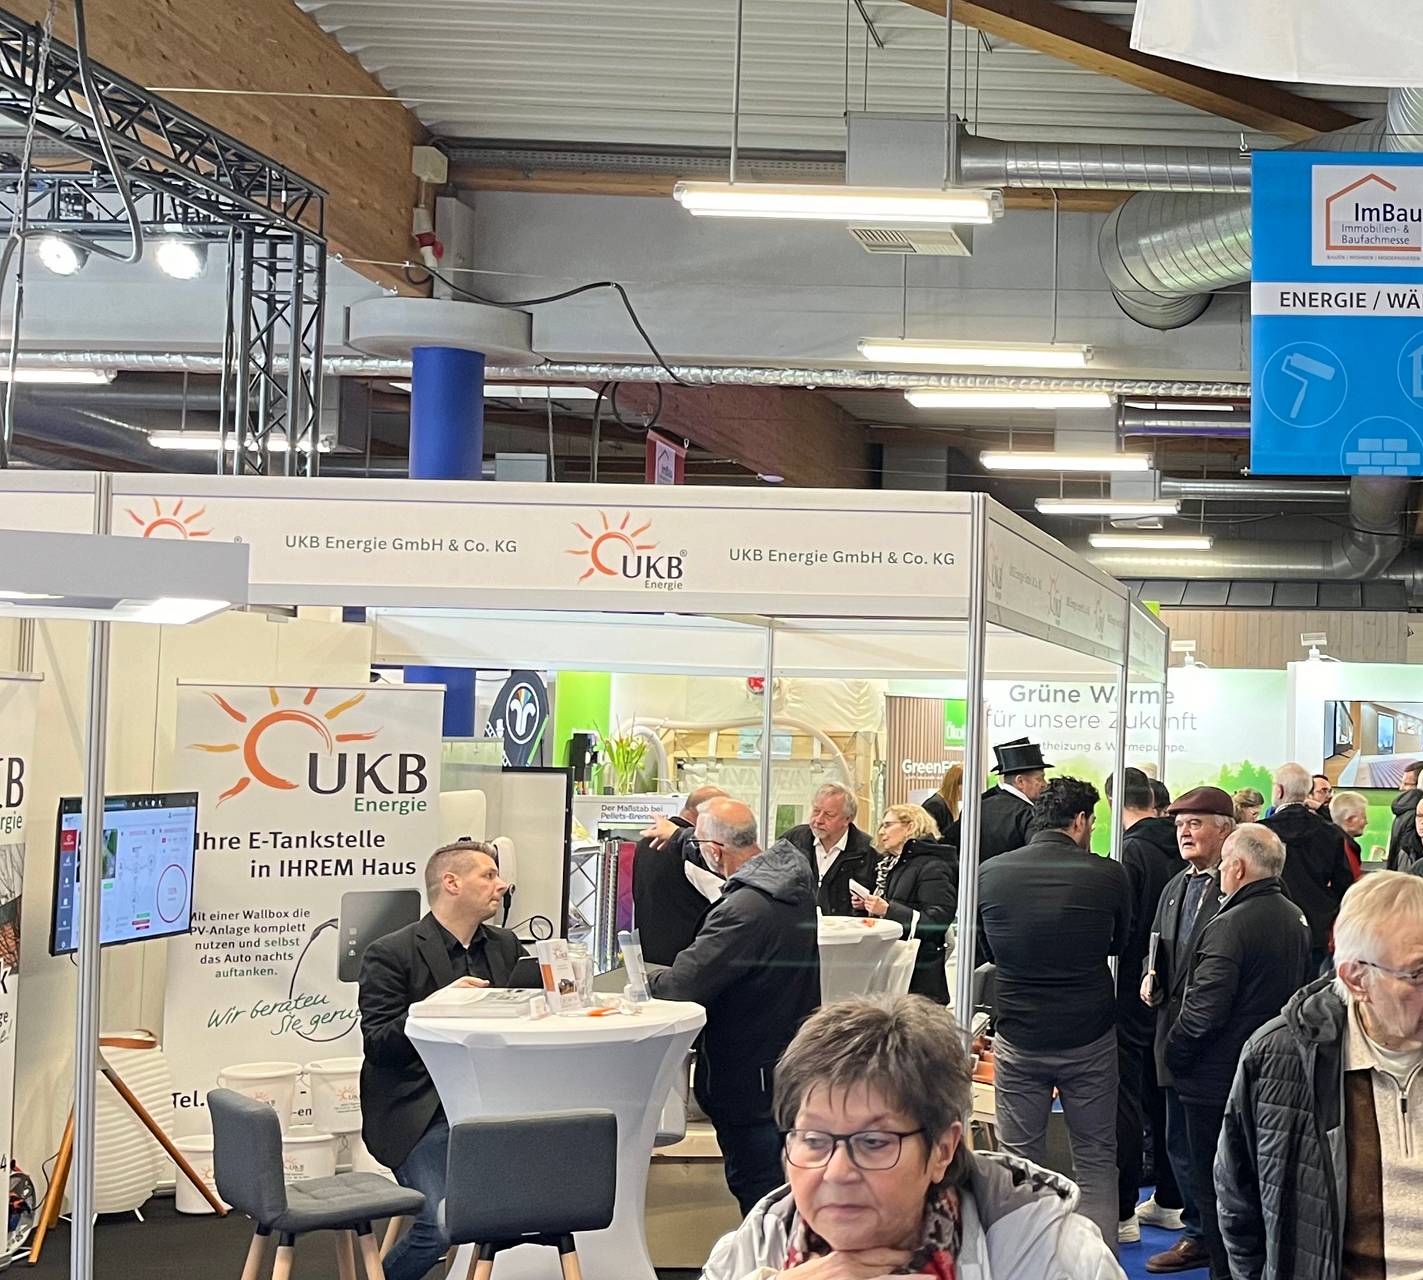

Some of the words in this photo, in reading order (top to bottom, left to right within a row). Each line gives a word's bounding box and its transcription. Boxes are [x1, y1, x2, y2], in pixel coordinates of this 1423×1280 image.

[1355, 203, 1422, 222] ImBau
[1342, 224, 1400, 233] Immobilien-
[1403, 225, 1409, 233] &
[1342, 235, 1410, 244] Baufachmesse
[1280, 291, 1367, 308] ENERGIE
[1373, 291, 1380, 310] /
[285, 535, 320, 549] UKB
[326, 536, 387, 553] Energie
[392, 537, 443, 552] GmbH
[448, 539, 459, 552] &
[464, 539, 489, 552] Co.
[495, 540, 517, 553] KG
[729, 548, 763, 562] UKB
[769, 549, 828, 566] Energie
[833, 550, 882, 565] GmbH
[888, 552, 897, 564] &
[903, 552, 928, 565] Co.
[934, 552, 955, 566] KG
[622, 555, 683, 580] UKB
[645, 580, 683, 591] Energie
[1009, 684, 1080, 703] Grüne
[1090, 685, 1175, 704] Wrme
[986, 707, 1016, 729] für
[1024, 713, 1100, 729] unsere
[308, 752, 428, 795] UKB
[354, 797, 428, 816] Energie
[601, 804, 614, 812] Der
[617, 804, 649, 812] Maßstab
[651, 804, 663, 812] bei
[196, 831, 241, 850] Ihre
[249, 830, 386, 849] E-Tankstelle
[250, 859, 271, 878] in
[280, 859, 353, 877] IHREM
[362, 858, 416, 876] Haus
[209, 911, 240, 921] einer
[242, 907, 289, 920] Wallbox
[292, 907, 310, 918] die
[189, 925, 250, 937] PV-Anlage
[254, 922, 306, 935] komplett
[195, 941, 235, 951] nutzen
[238, 938, 261, 949] und
[264, 936, 300, 948] selbst
[200, 953, 221, 964] das
[224, 952, 251, 963] Auto
[255, 950, 294, 962] nachts
[215, 966, 278, 978] auftanken.
[207, 1005, 247, 1029] Wir
[172, 1090, 205, 1108] Tel.
